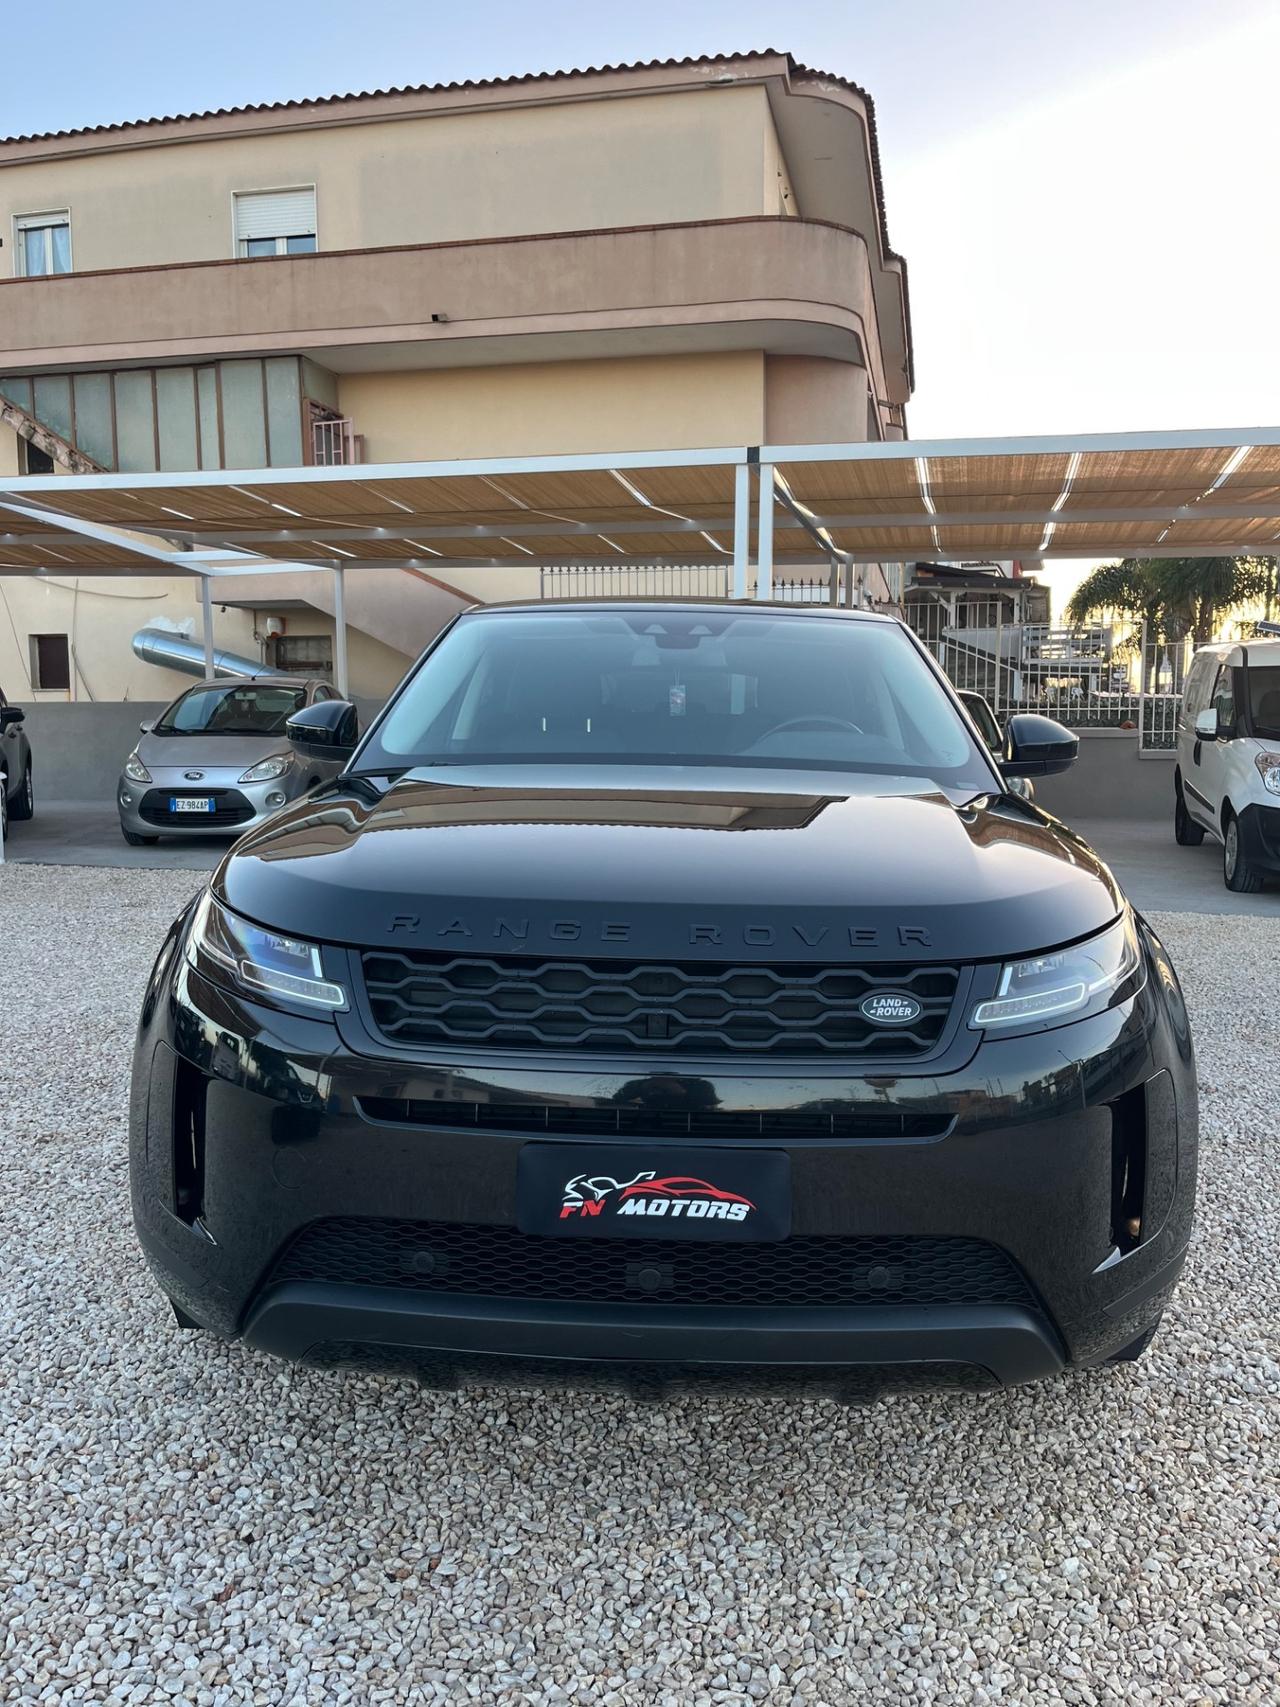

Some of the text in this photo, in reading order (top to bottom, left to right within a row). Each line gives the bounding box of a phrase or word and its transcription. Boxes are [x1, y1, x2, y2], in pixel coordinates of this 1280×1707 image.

[387, 912, 933, 948] RANGE ROVER
[873, 998, 902, 1007] LAND
[876, 1007, 912, 1016] ROVER
[559, 1198, 751, 1221] FN MOTORS
